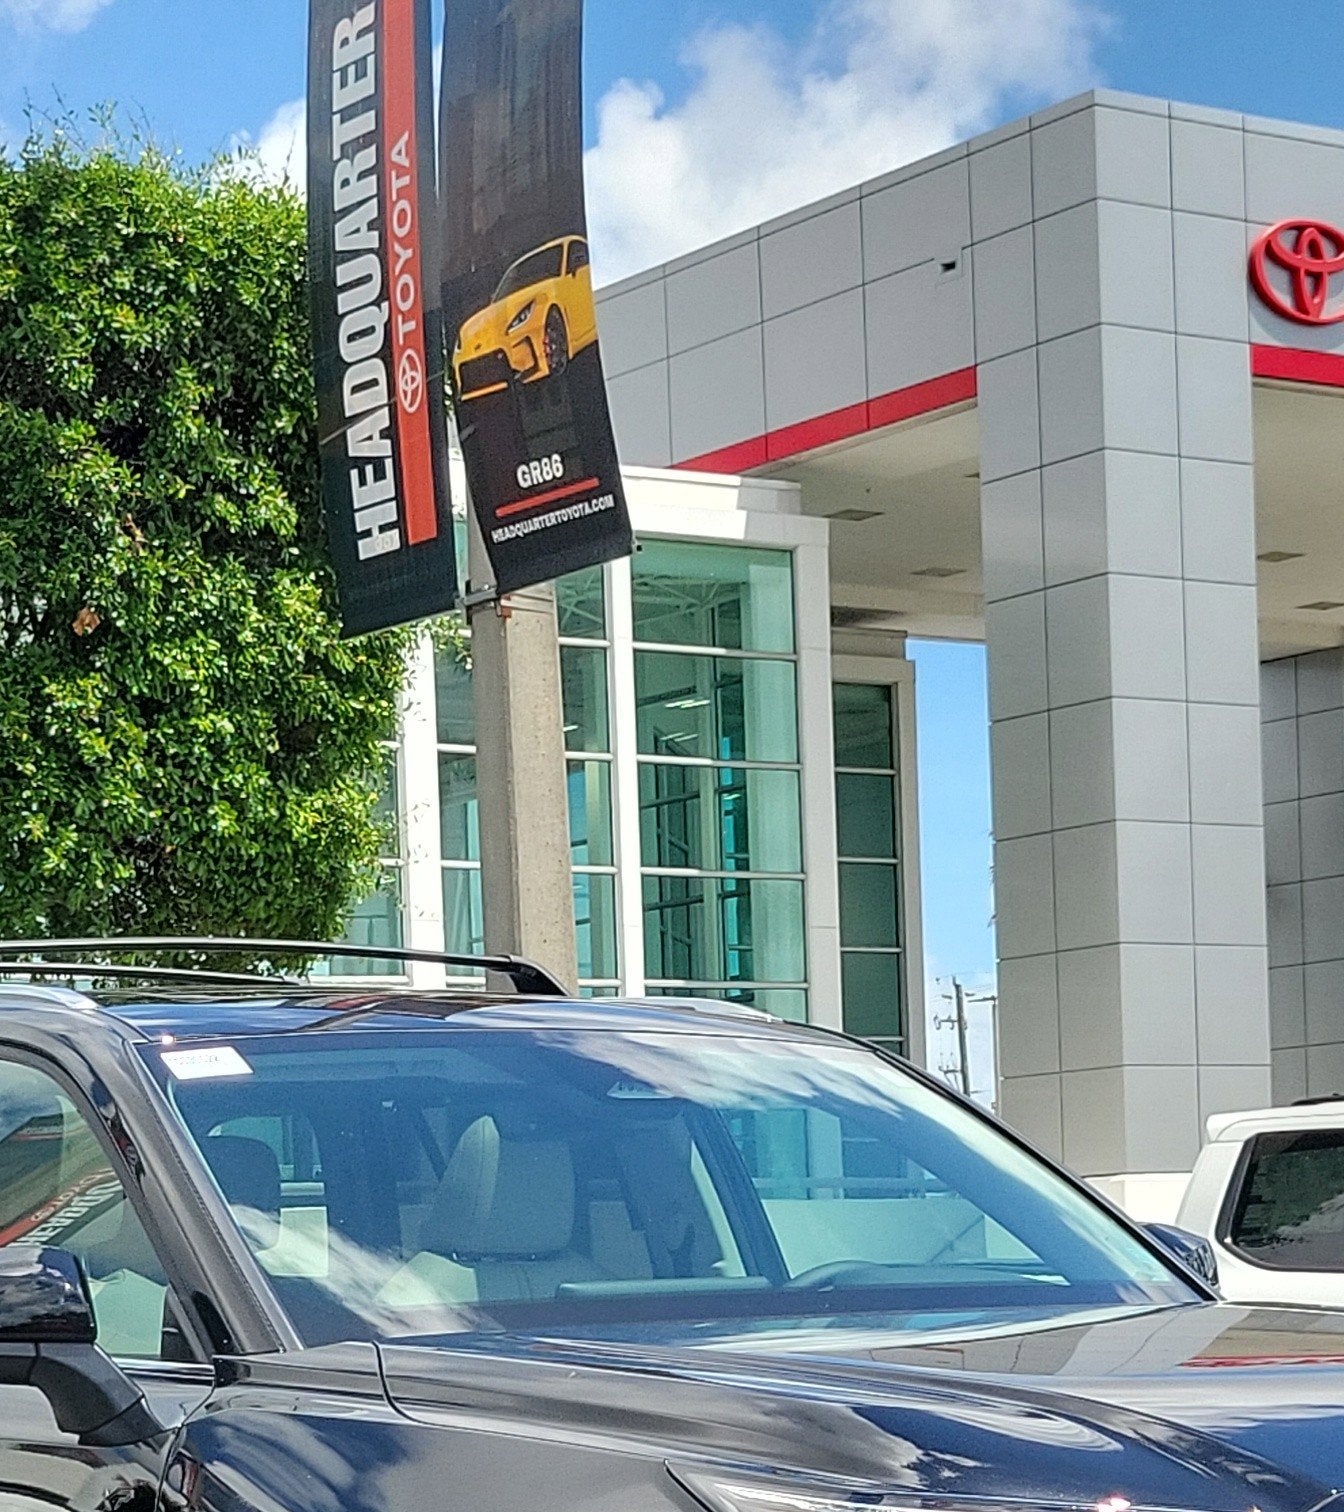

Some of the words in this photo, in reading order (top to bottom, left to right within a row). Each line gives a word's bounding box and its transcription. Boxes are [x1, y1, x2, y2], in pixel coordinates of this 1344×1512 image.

[332, 1, 402, 561] HEADQUARTER
[390, 130, 418, 345] TOYOTA
[491, 494, 615, 543] HEADQUARTERTOYOTA.COM
[517, 453, 564, 489] GR86
